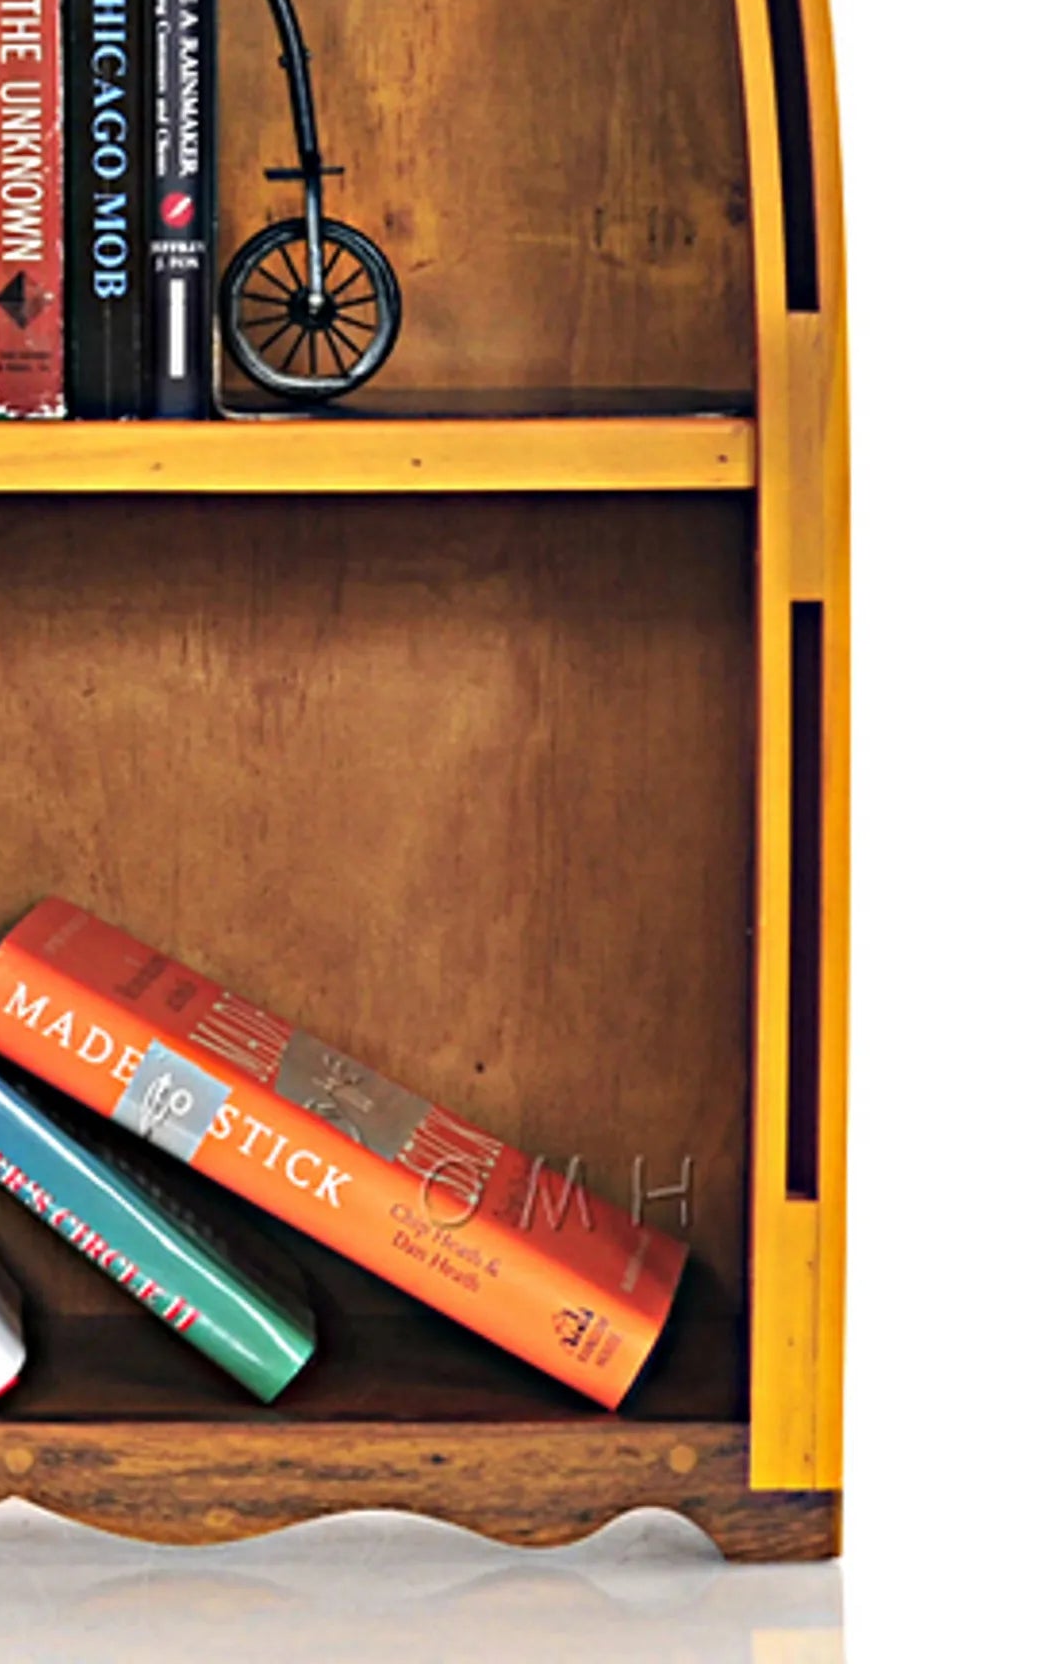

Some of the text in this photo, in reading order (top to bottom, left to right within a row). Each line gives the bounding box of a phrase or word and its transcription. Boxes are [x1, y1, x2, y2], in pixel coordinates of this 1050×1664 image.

[178, 9, 200, 30] A
[178, 36, 200, 178] RAINMAKER
[92, 193, 129, 299] MOB
[3, 980, 353, 1208] MADE to STICK
[49, 1204, 168, 1305] CIRCLE
